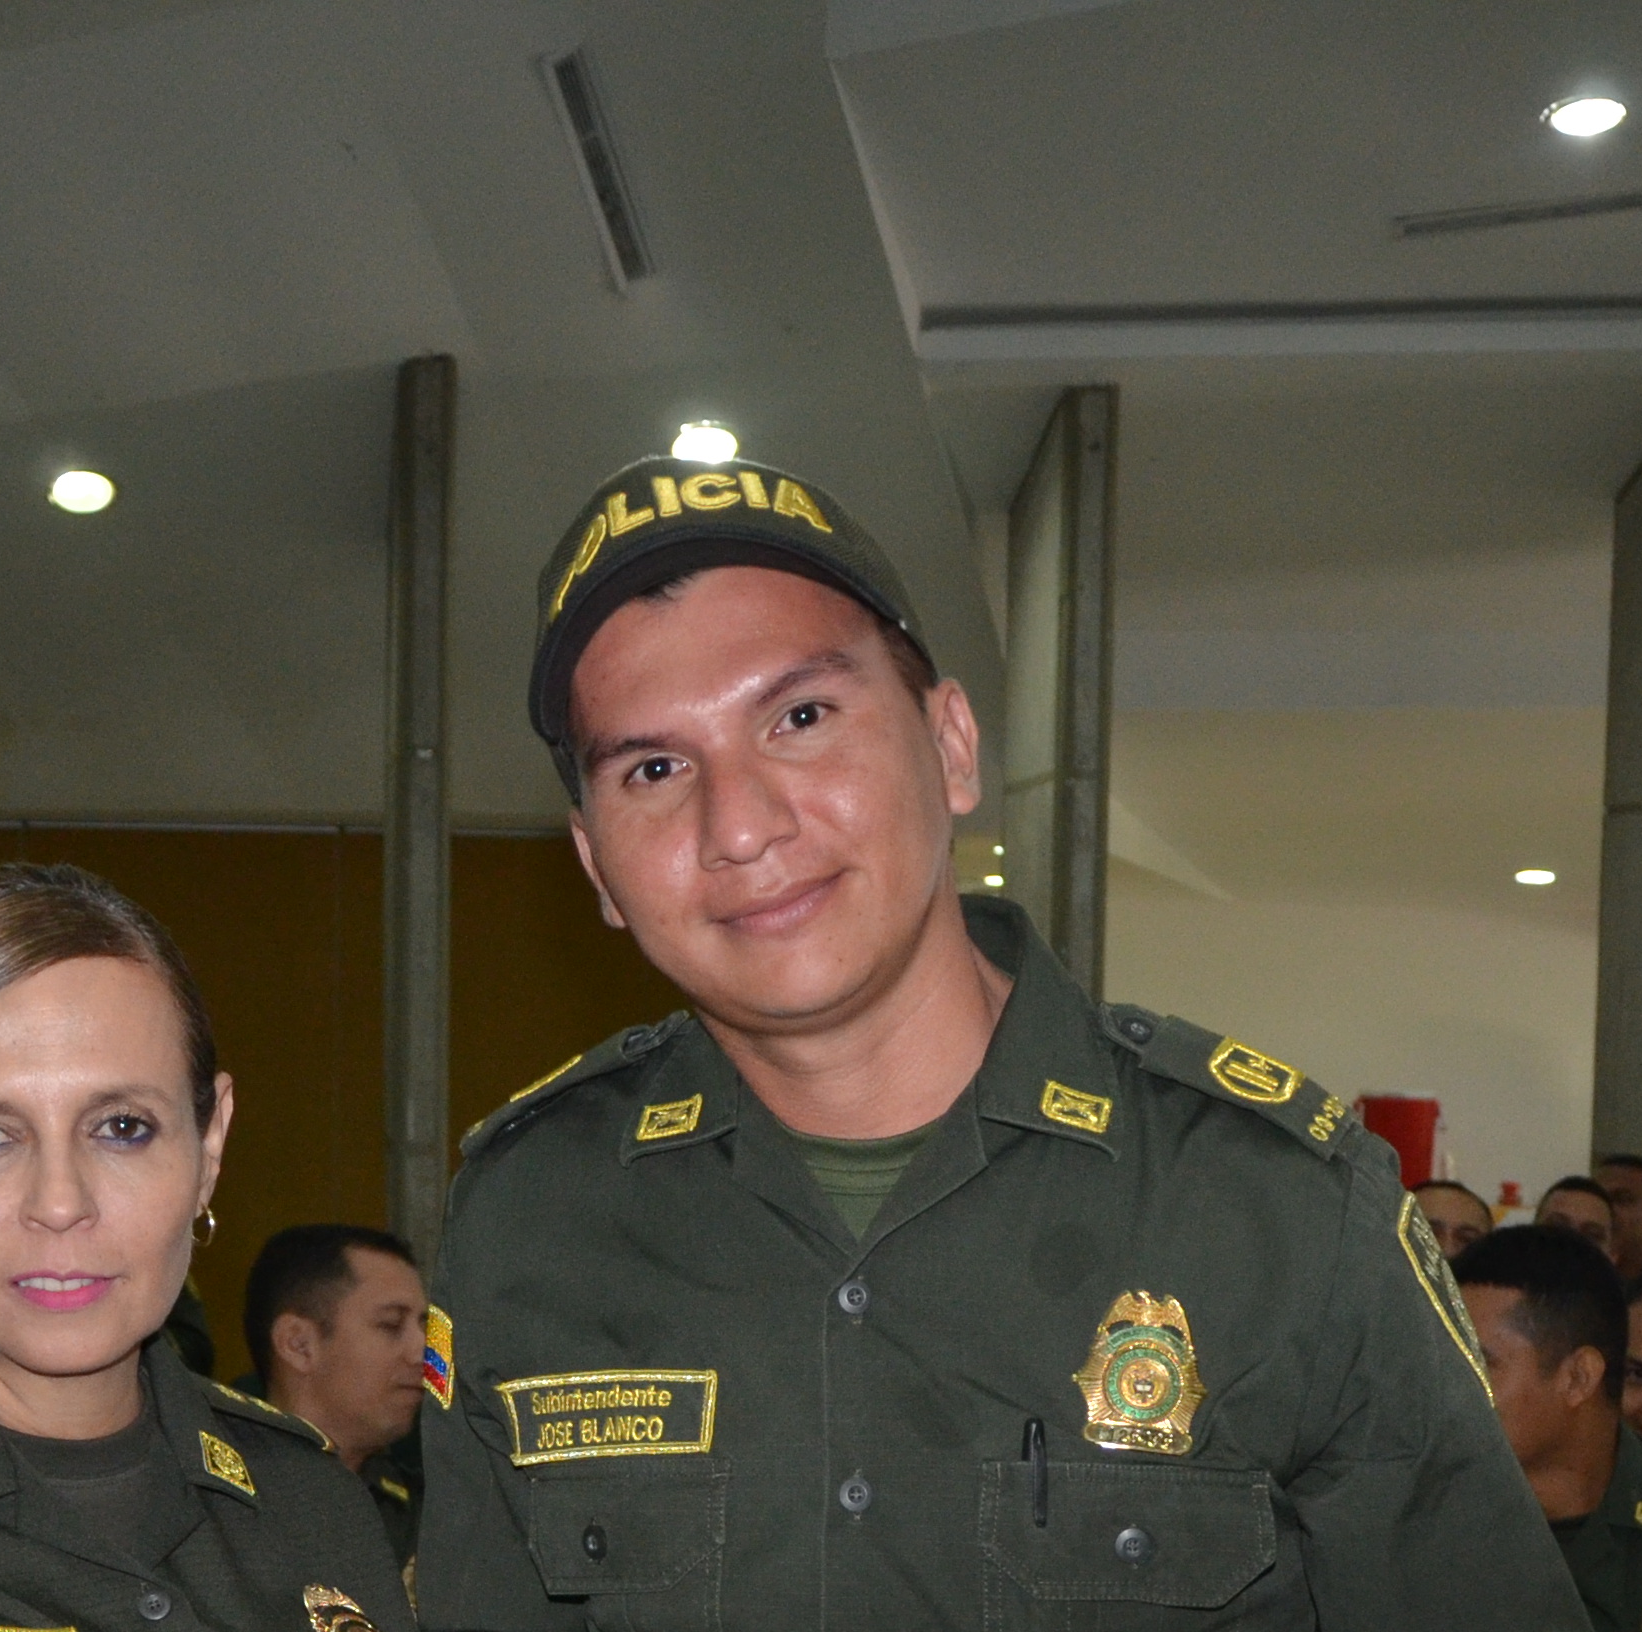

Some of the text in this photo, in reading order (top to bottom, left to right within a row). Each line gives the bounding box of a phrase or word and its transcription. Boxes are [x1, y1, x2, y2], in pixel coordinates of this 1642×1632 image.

[550, 471, 833, 621] OLICIA
[531, 1384, 673, 1415] Subintendente
[536, 1415, 665, 1450] JOSE BLANCO
